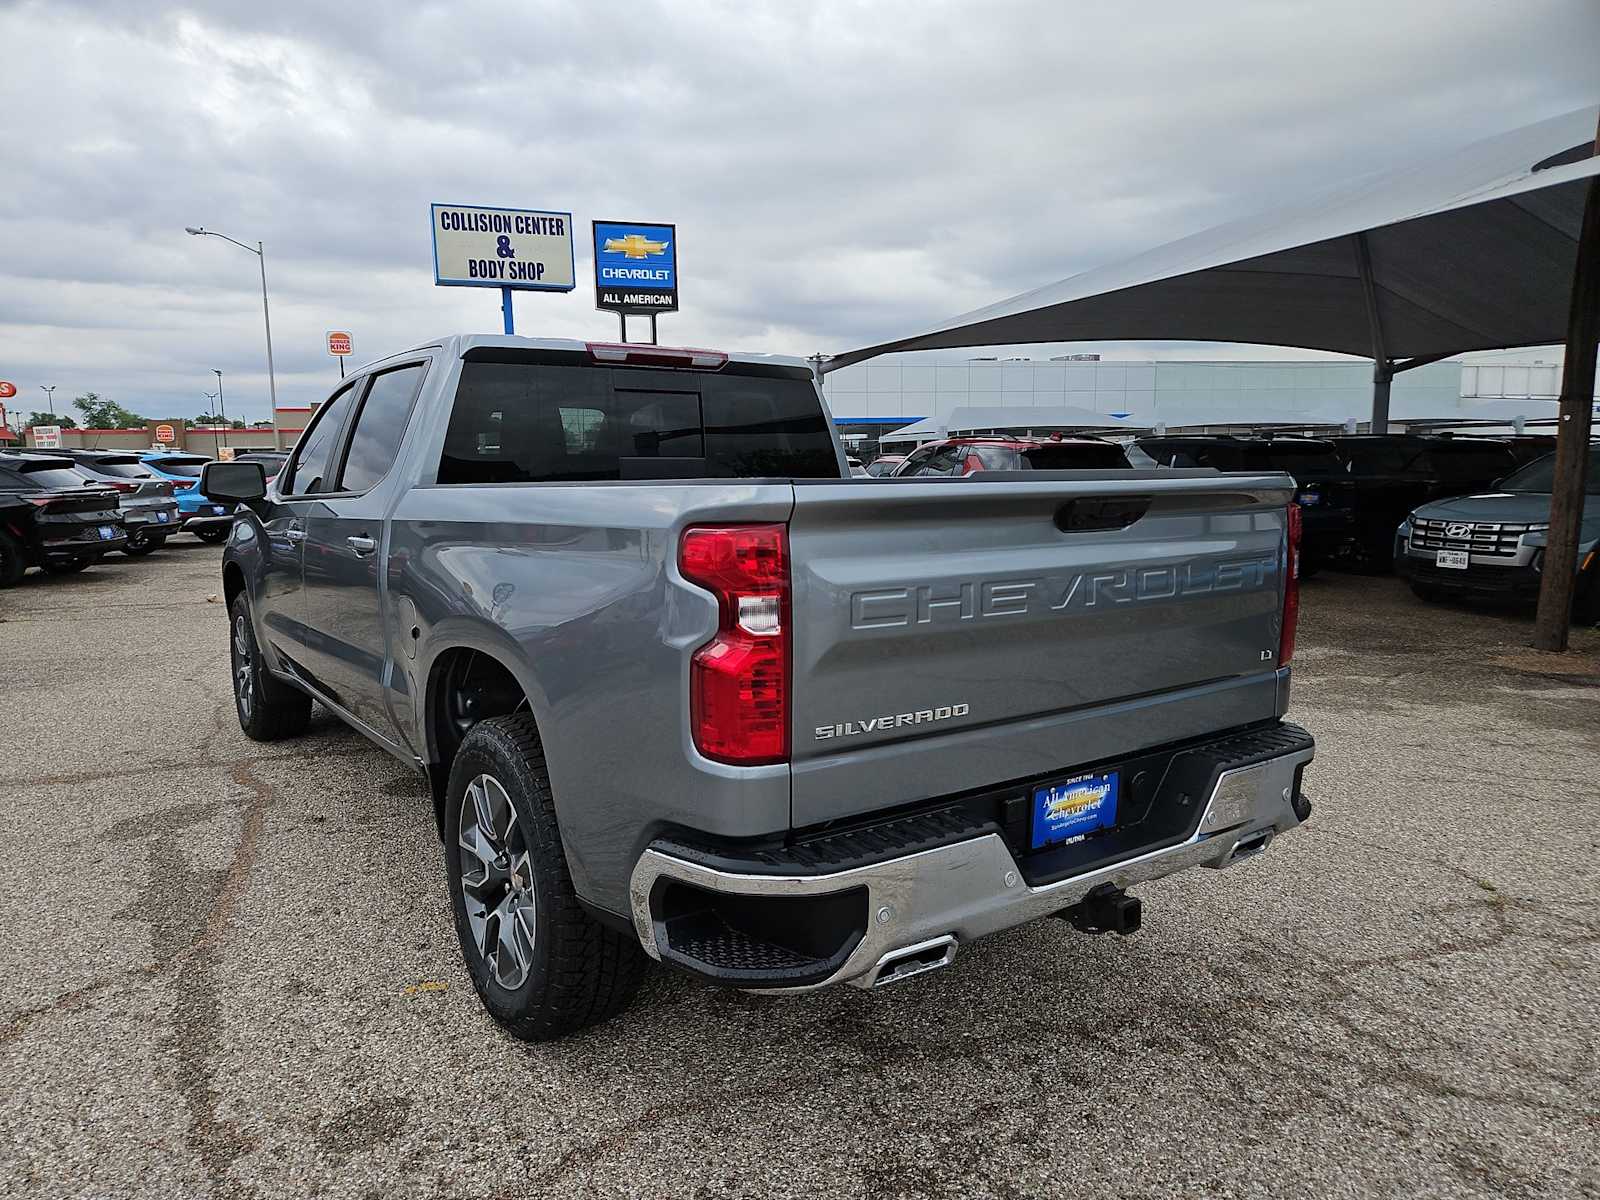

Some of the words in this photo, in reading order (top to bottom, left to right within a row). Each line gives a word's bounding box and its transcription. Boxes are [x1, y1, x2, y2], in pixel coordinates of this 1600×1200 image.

[441, 211, 512, 233] COLLISION
[515, 215, 565, 236] CENTER
[496, 235, 515, 259] &
[468, 259, 505, 280] BODY
[509, 261, 545, 281] SHOP
[602, 267, 670, 281] CHEVROLET
[603, 293, 621, 304] ALL
[623, 294, 672, 305] AMERICAN
[851, 556, 1276, 630] CHEVROLET
[815, 703, 969, 740] SILVERADO
[1043, 793, 1059, 808] All
[1061, 783, 1111, 801] American
[1051, 799, 1101, 820] Chevrolet
